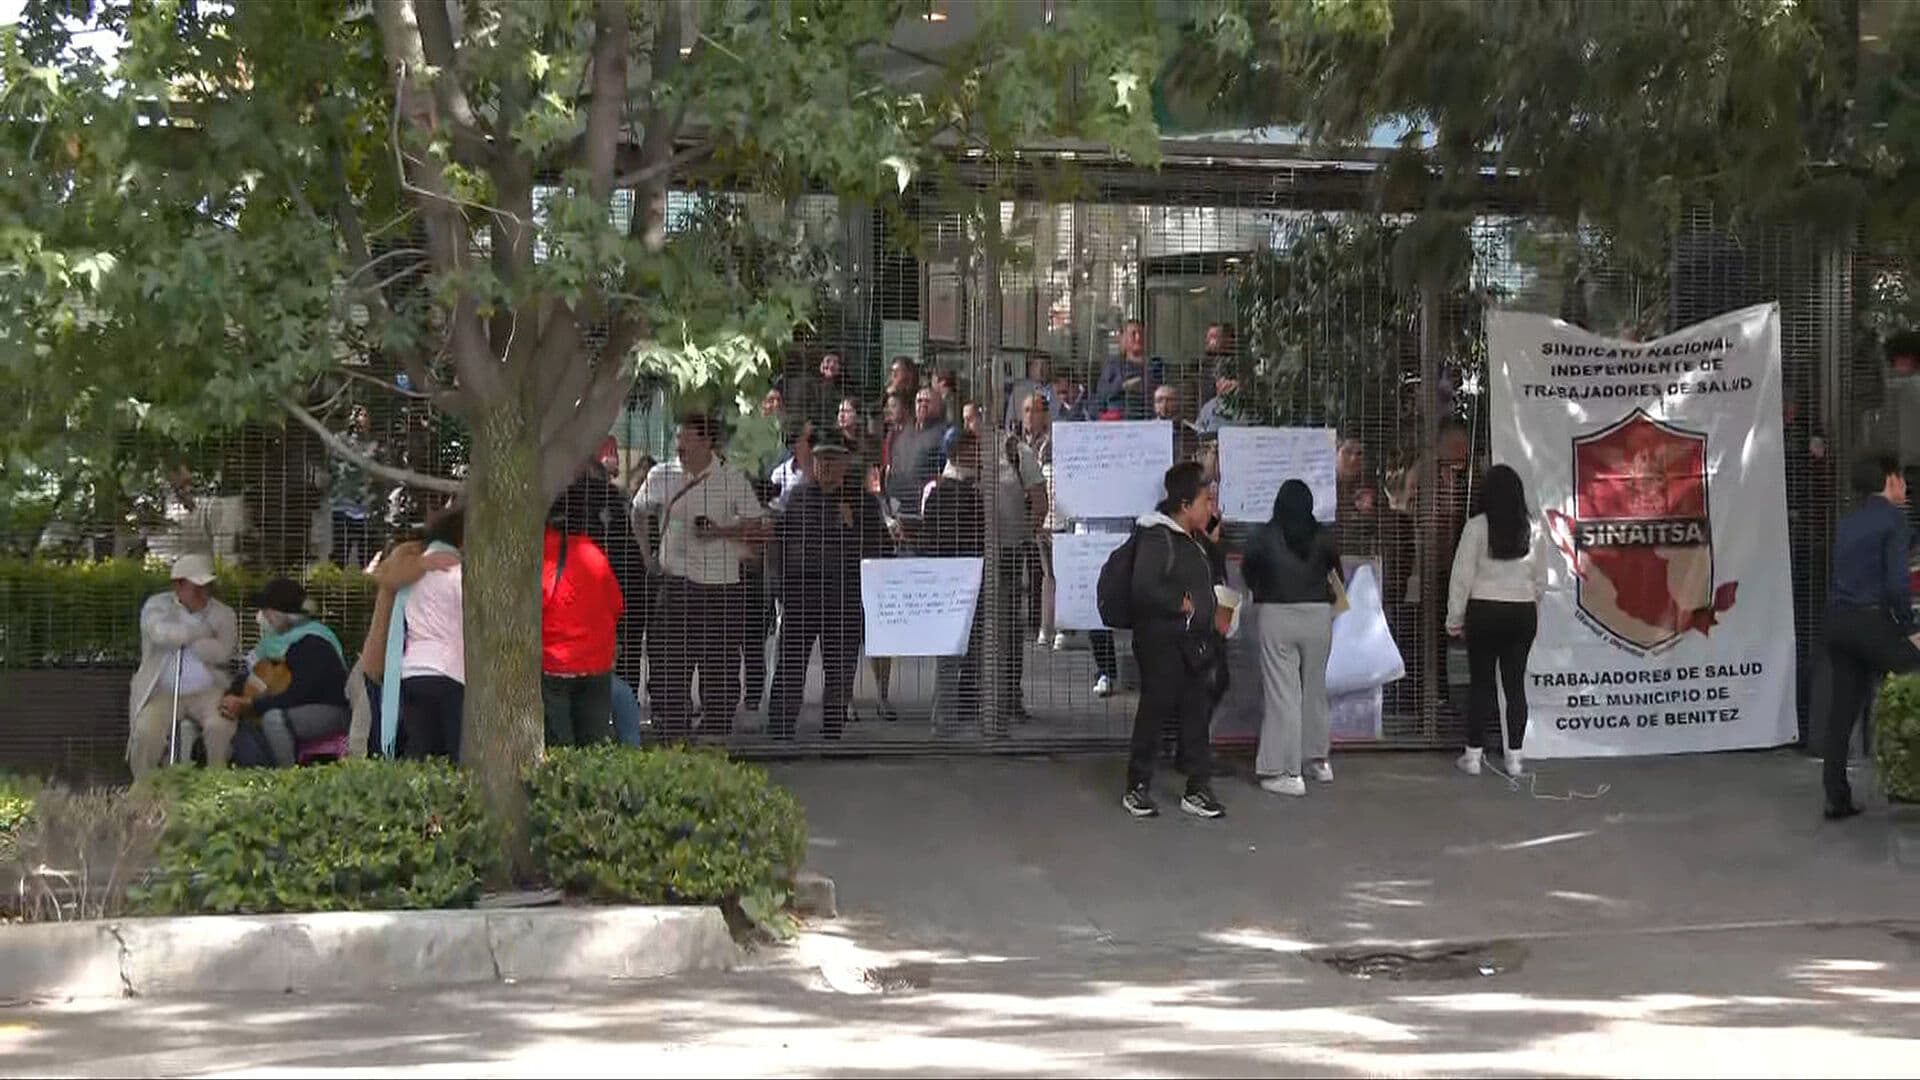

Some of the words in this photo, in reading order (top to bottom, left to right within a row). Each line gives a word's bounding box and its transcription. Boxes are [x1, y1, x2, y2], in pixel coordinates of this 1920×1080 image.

[1647, 337, 1733, 358] NACIONAL
[1551, 362, 1695, 376] INDEPENDIENTE
[1700, 358, 1723, 370] DE
[1523, 383, 1661, 399] TRABAJADORES
[1667, 382, 1693, 395] DE
[1697, 377, 1752, 393] SALUD
[1582, 522, 1702, 545] SINAITSA
[1531, 669, 1671, 687] TRABAJADORES
[1677, 666, 1699, 681] DE
[1705, 662, 1763, 678] SALUD
[1567, 694, 1600, 708] DEL
[1607, 688, 1701, 706] MUNICIPIO
[1706, 686, 1730, 701] DE
[1556, 715, 1631, 730] COYUCA
[1637, 714, 1659, 727] DE
[1664, 708, 1740, 725] BENITEZ
